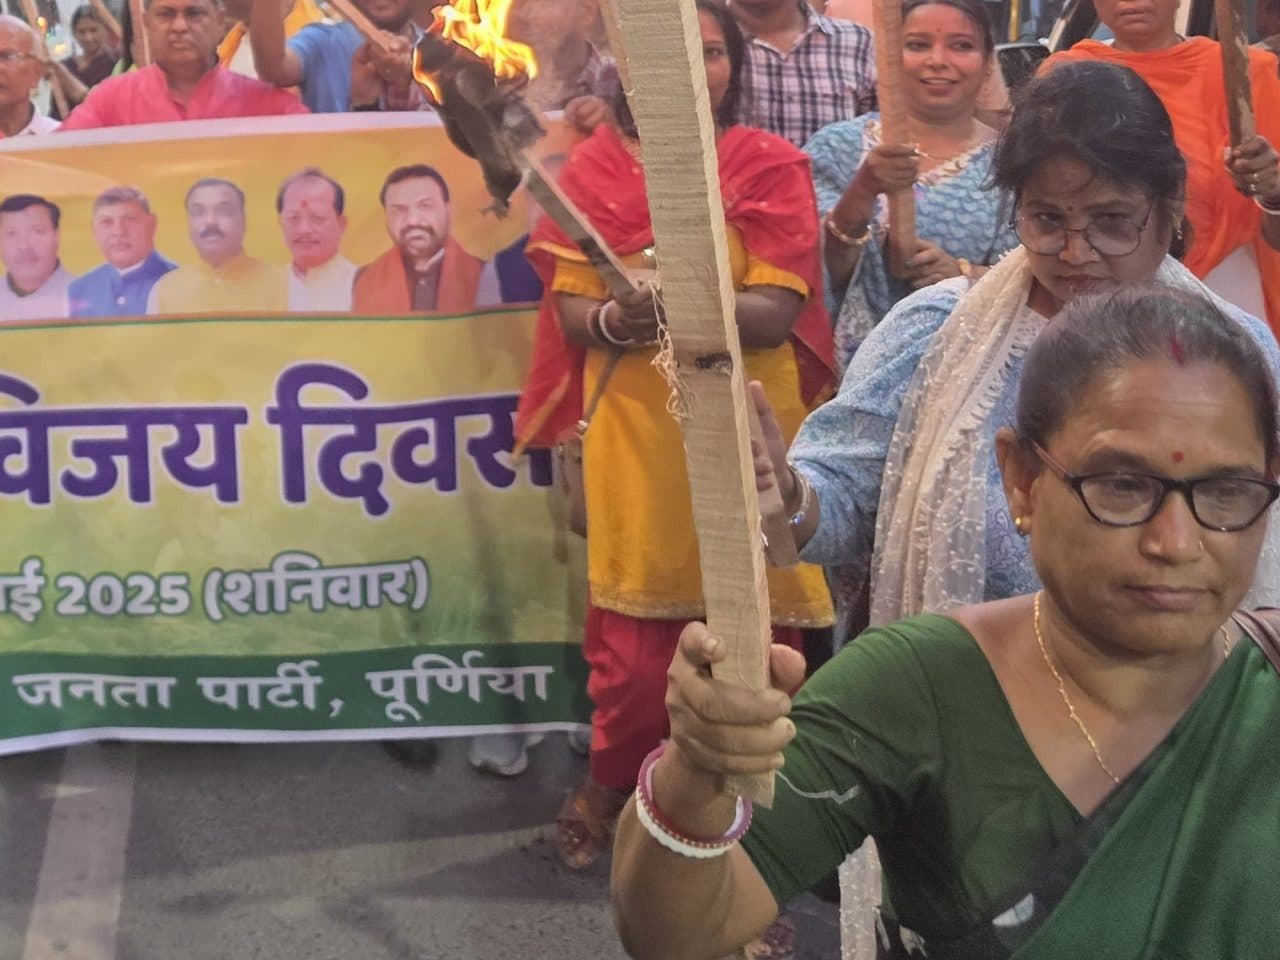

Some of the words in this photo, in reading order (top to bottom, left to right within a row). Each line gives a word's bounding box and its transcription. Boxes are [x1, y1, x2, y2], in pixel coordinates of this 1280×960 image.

[54, 574, 192, 616] 2025
[202, 551, 432, 620] (शनिवार)
[13, 674, 177, 709] जनता
[198, 659, 343, 717] पार्टी,
[365, 651, 555, 722] पूर्णिया
